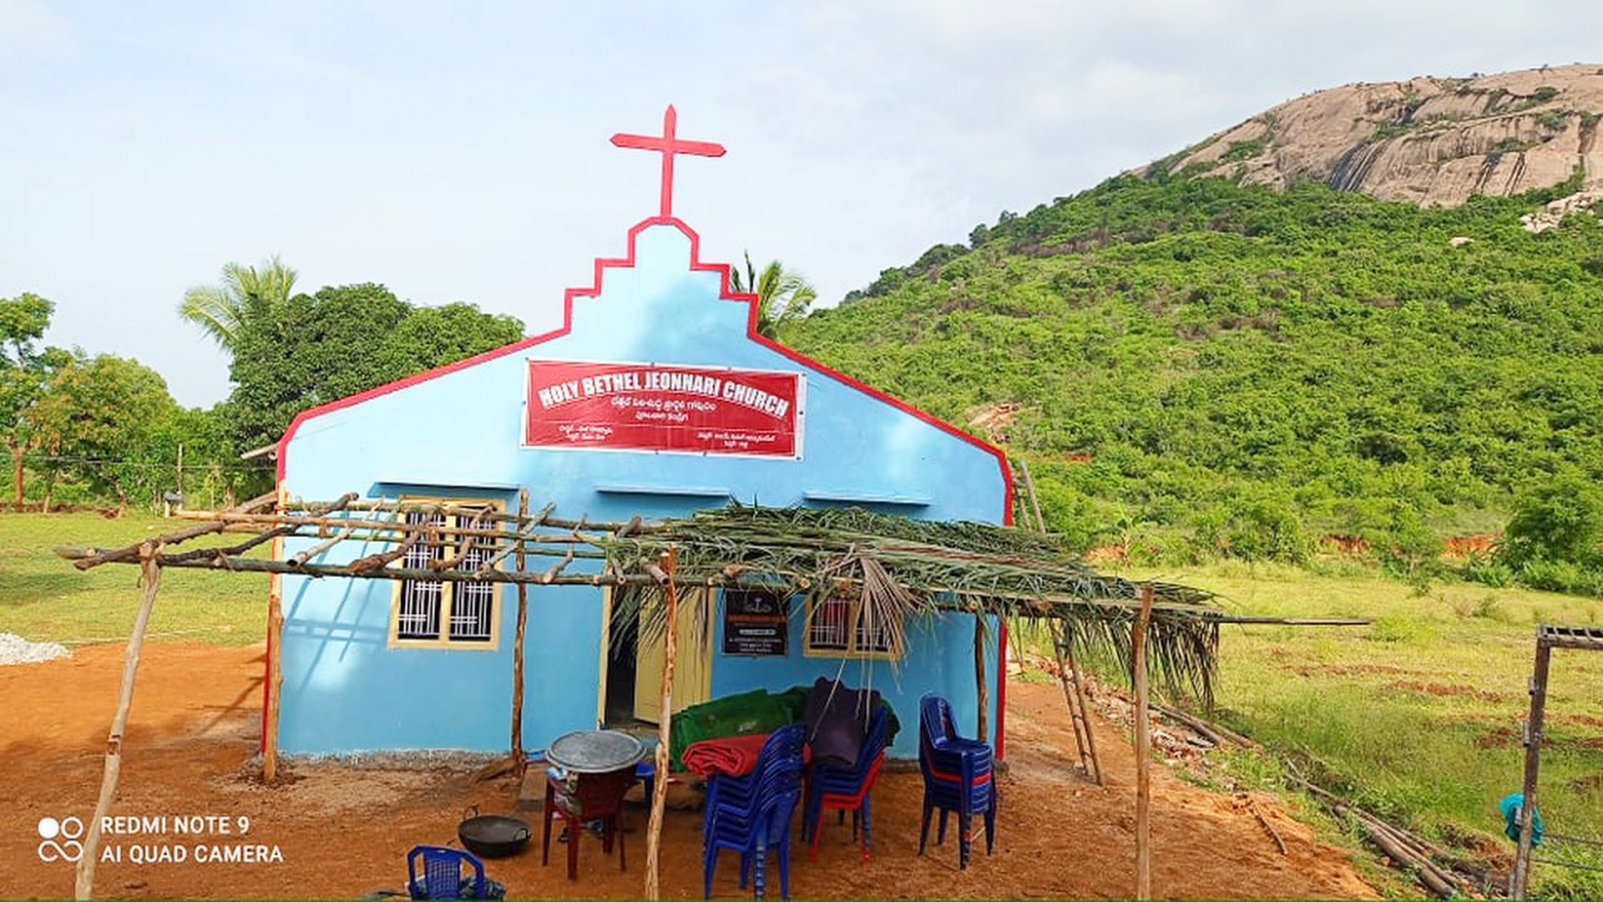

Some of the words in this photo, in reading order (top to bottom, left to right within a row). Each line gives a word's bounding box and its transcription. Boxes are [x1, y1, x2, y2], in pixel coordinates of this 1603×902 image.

[538, 380, 579, 409] HOLY
[582, 374, 640, 396] BETHEL
[722, 380, 789, 417] CHURCH
